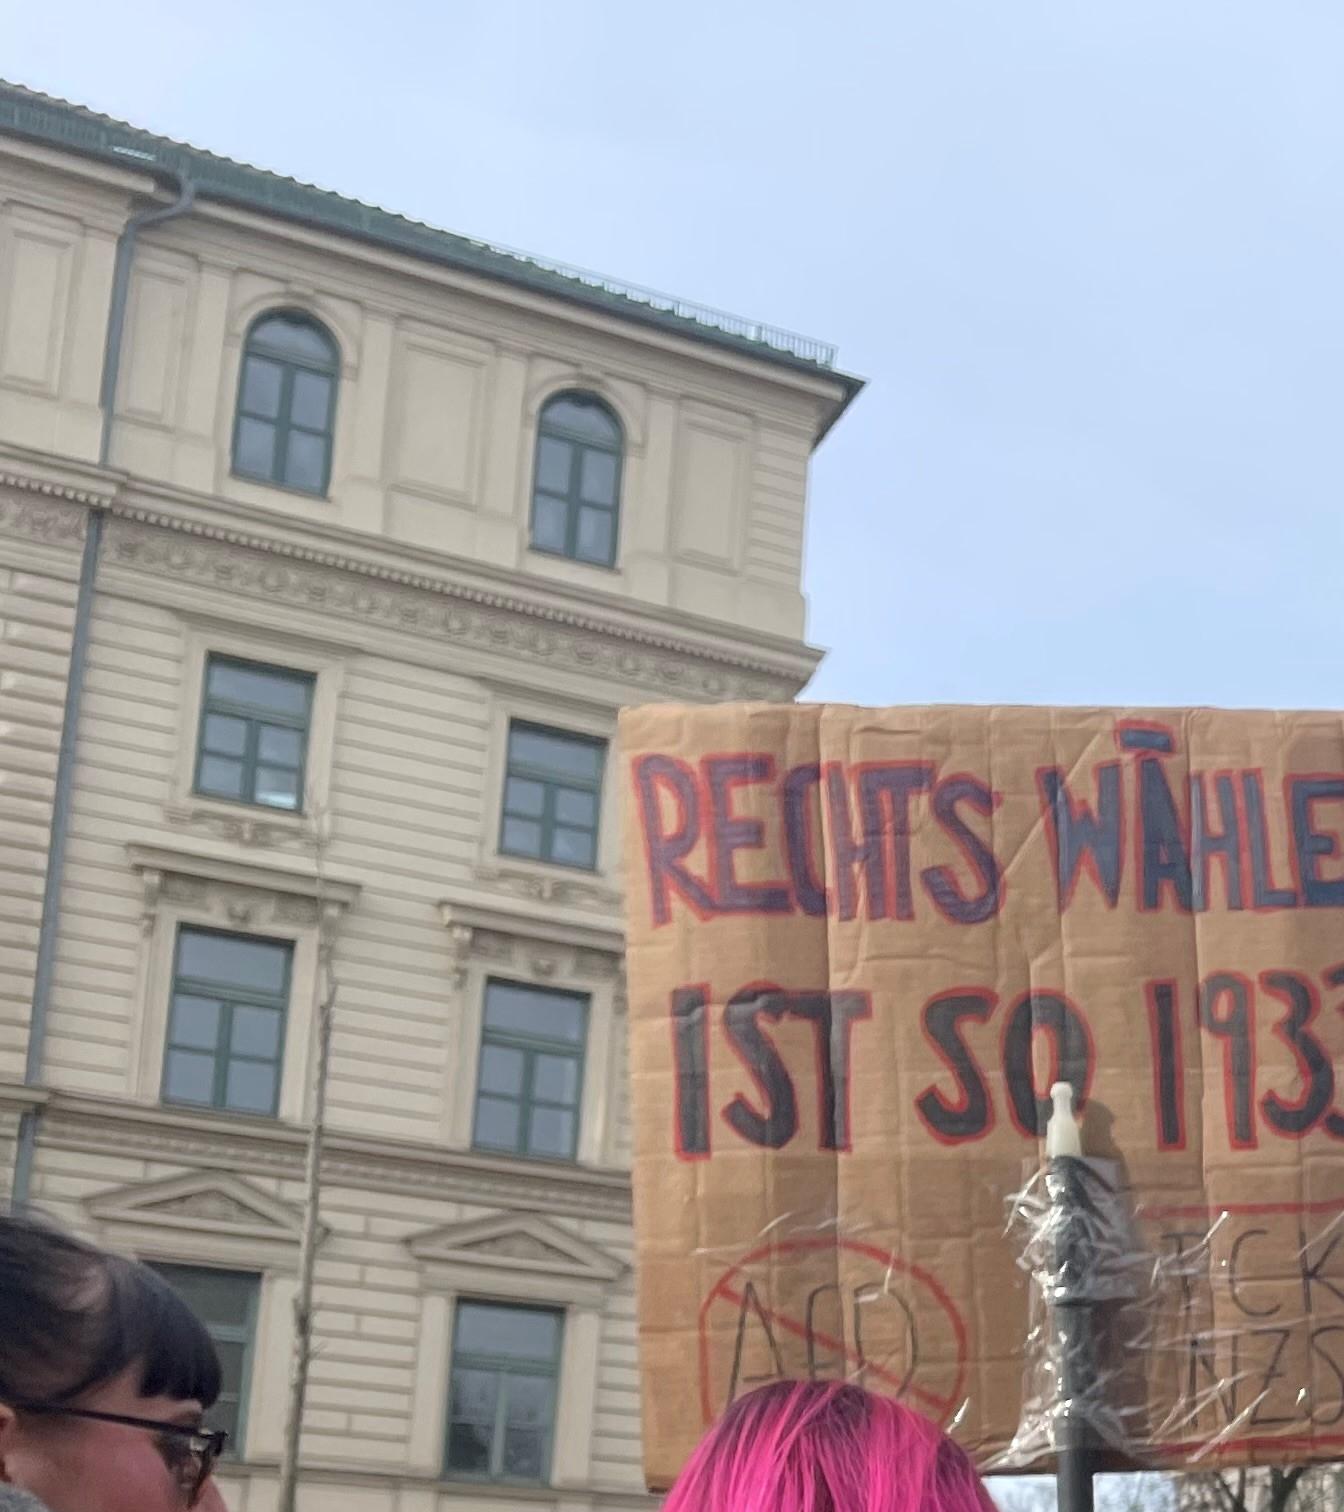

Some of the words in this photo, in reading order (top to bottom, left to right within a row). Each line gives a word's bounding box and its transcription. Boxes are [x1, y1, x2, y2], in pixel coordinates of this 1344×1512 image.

[630, 750, 1003, 926] RECHTS
[669, 980, 874, 1161] IST
[915, 986, 1097, 1140] SO
